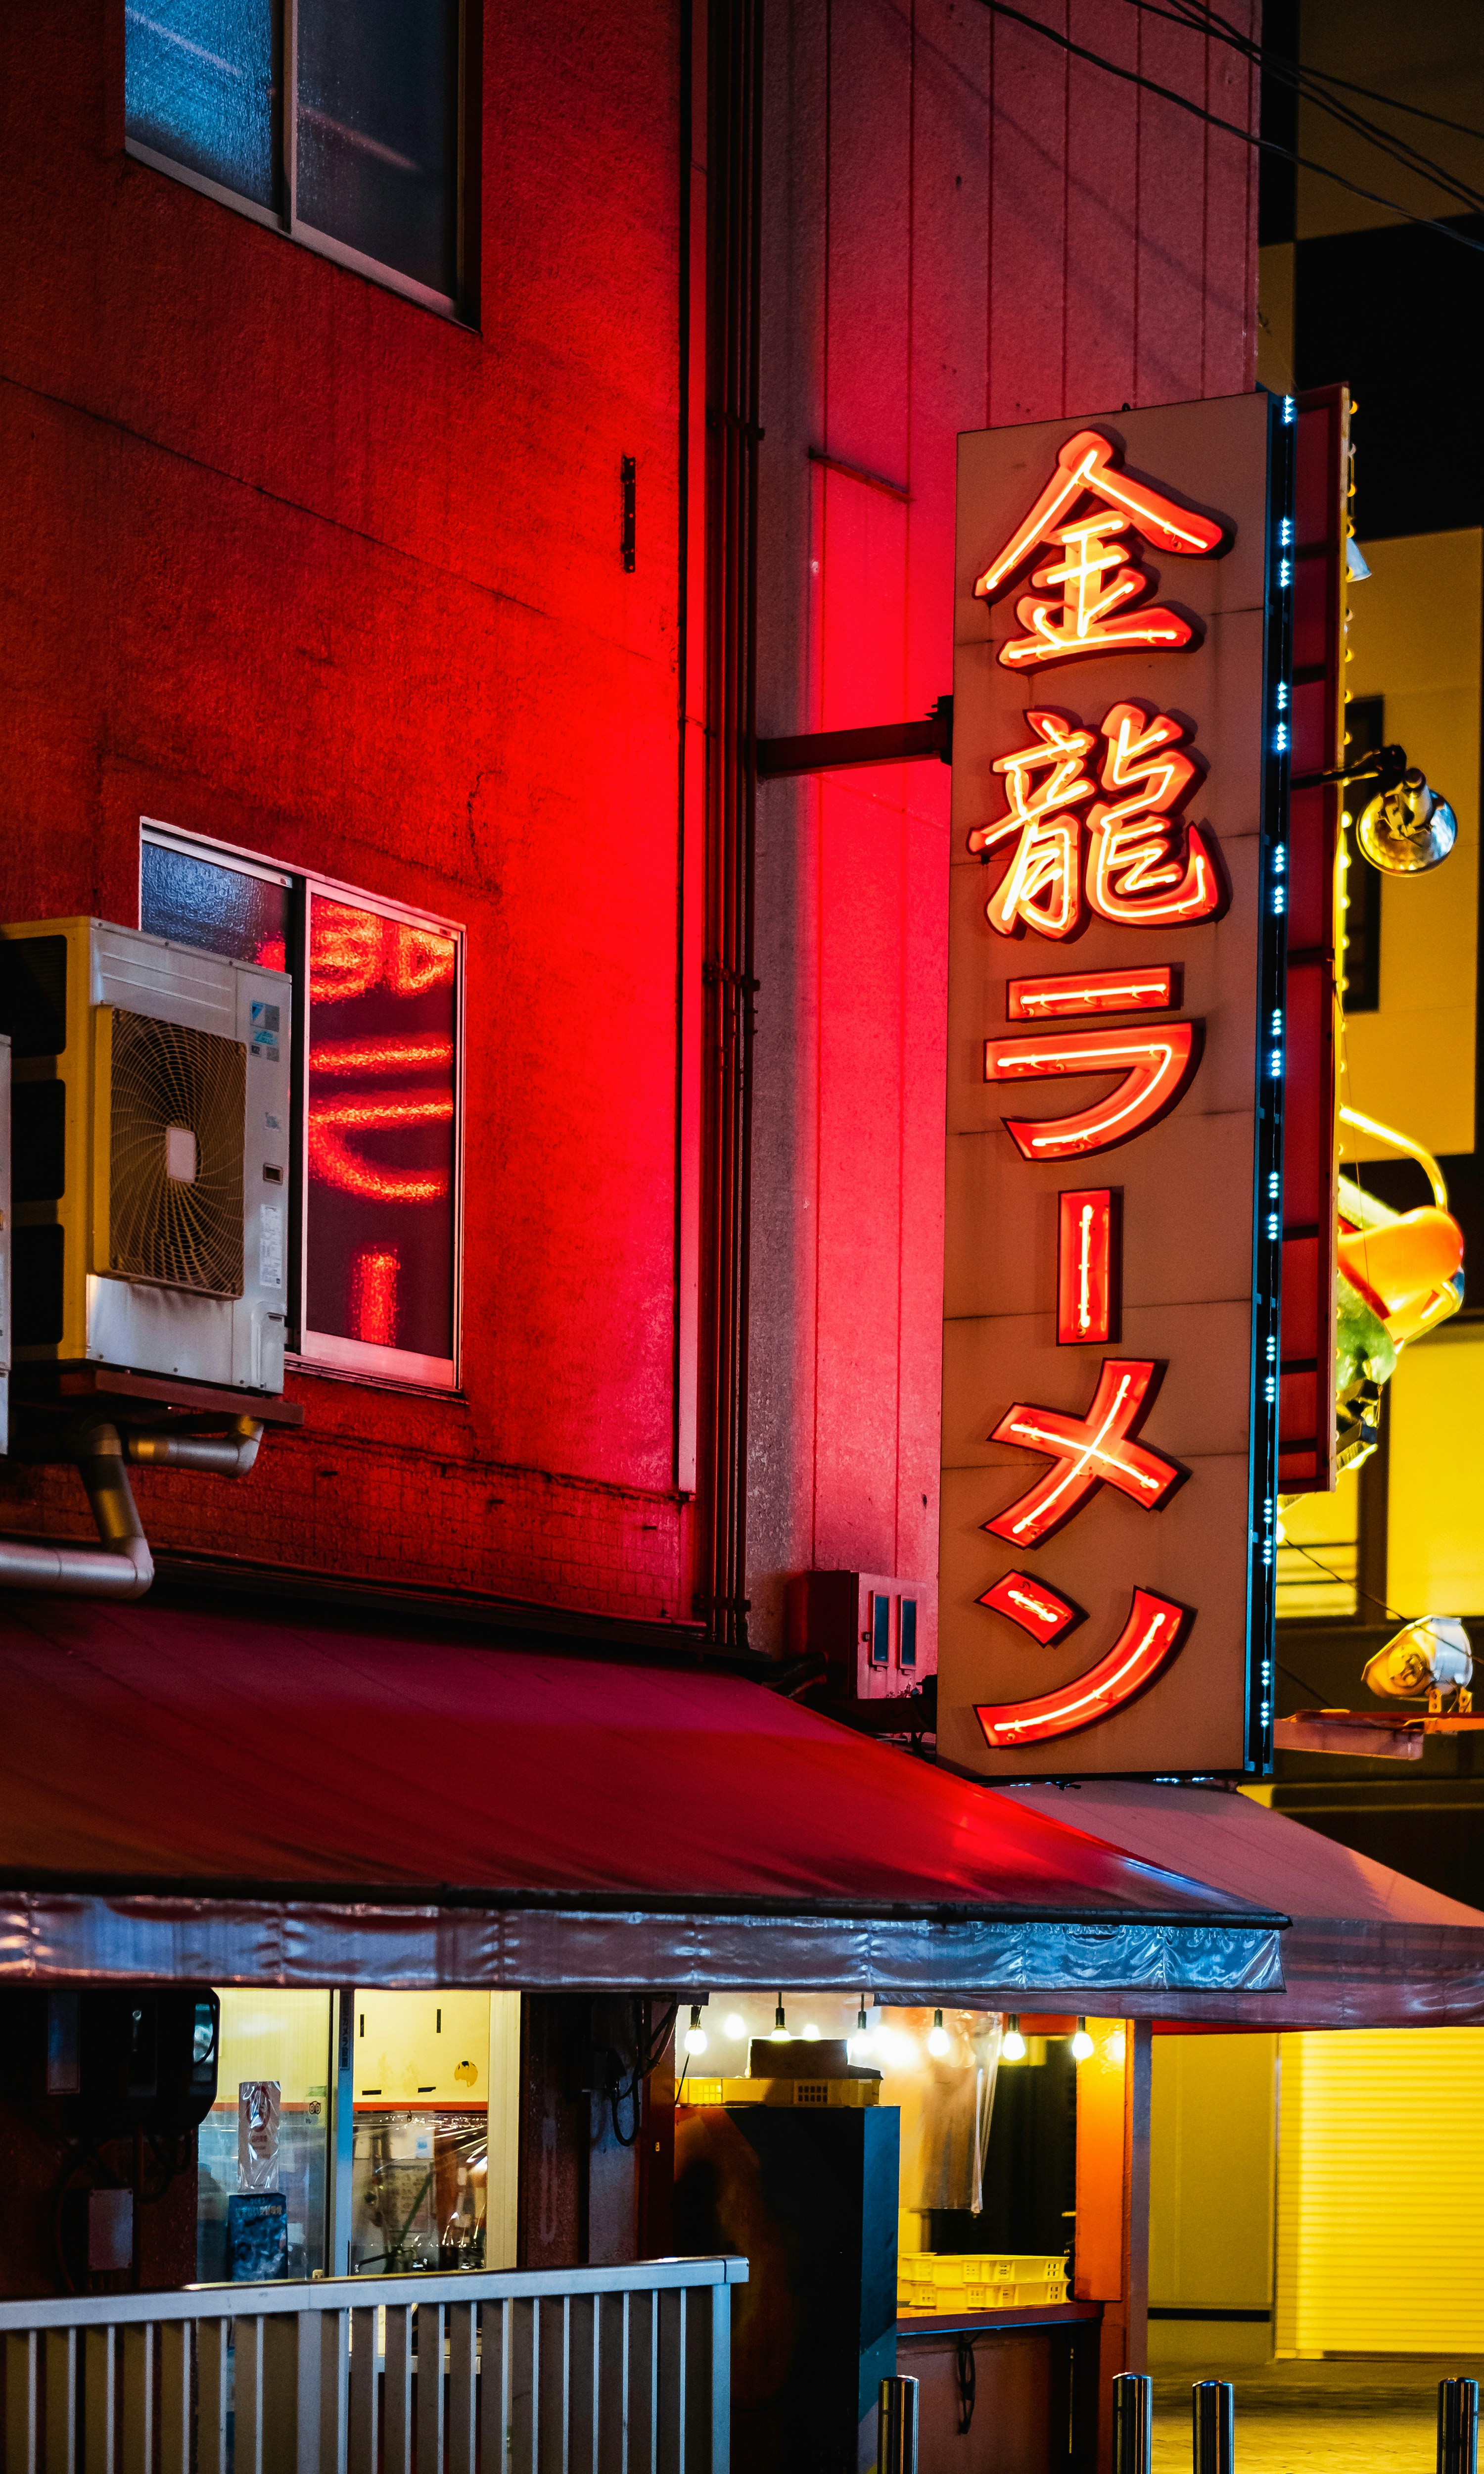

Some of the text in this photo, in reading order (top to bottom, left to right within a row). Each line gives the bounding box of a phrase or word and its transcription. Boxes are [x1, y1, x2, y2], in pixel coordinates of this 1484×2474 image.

[968, 429, 1223, 1748] 金龍ラーメン
